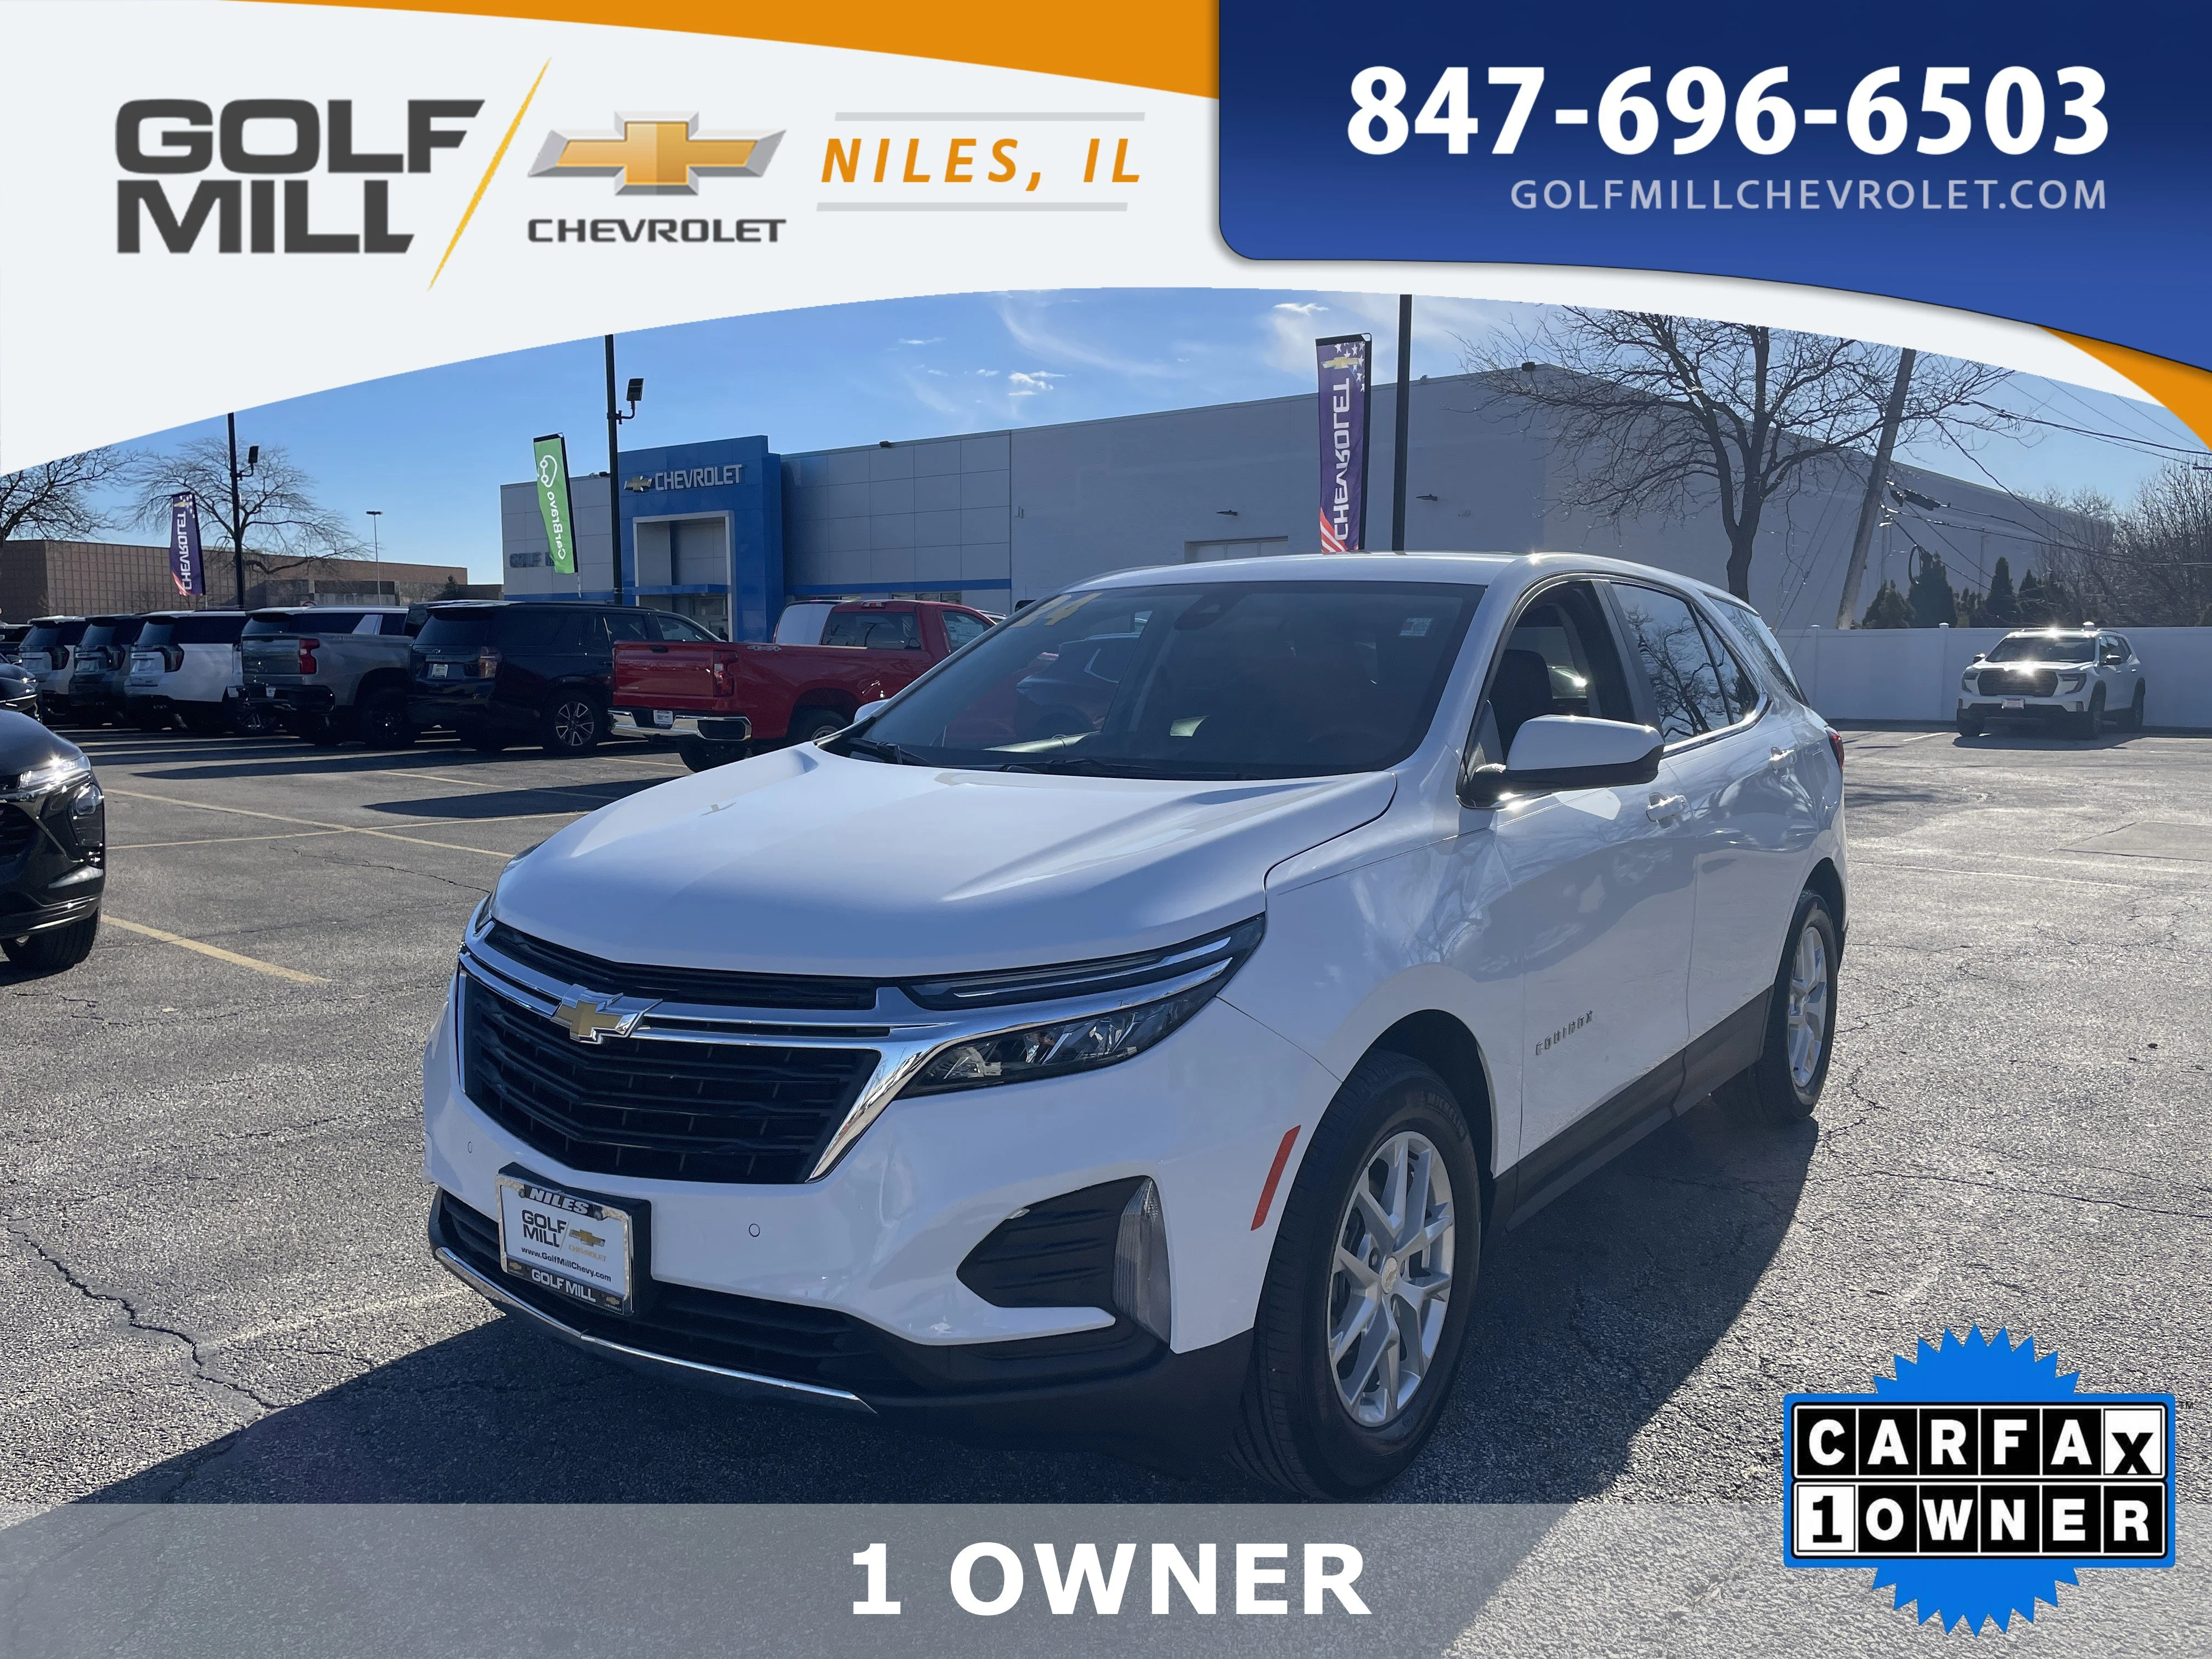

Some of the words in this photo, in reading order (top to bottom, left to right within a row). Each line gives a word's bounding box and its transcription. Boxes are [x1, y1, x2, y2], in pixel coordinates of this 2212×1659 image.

[654, 464, 742, 491] CHEVROLET
[1535, 1010, 1594, 1056] EQUINOX
[529, 1188, 590, 1215] NILES
[522, 1209, 567, 1234] GOLF
[523, 1224, 561, 1248] MILL
[521, 1246, 612, 1282] www.GolfMillChevy.com
[531, 1268, 565, 1290] GOLF
[566, 1283, 596, 1302] MILL
